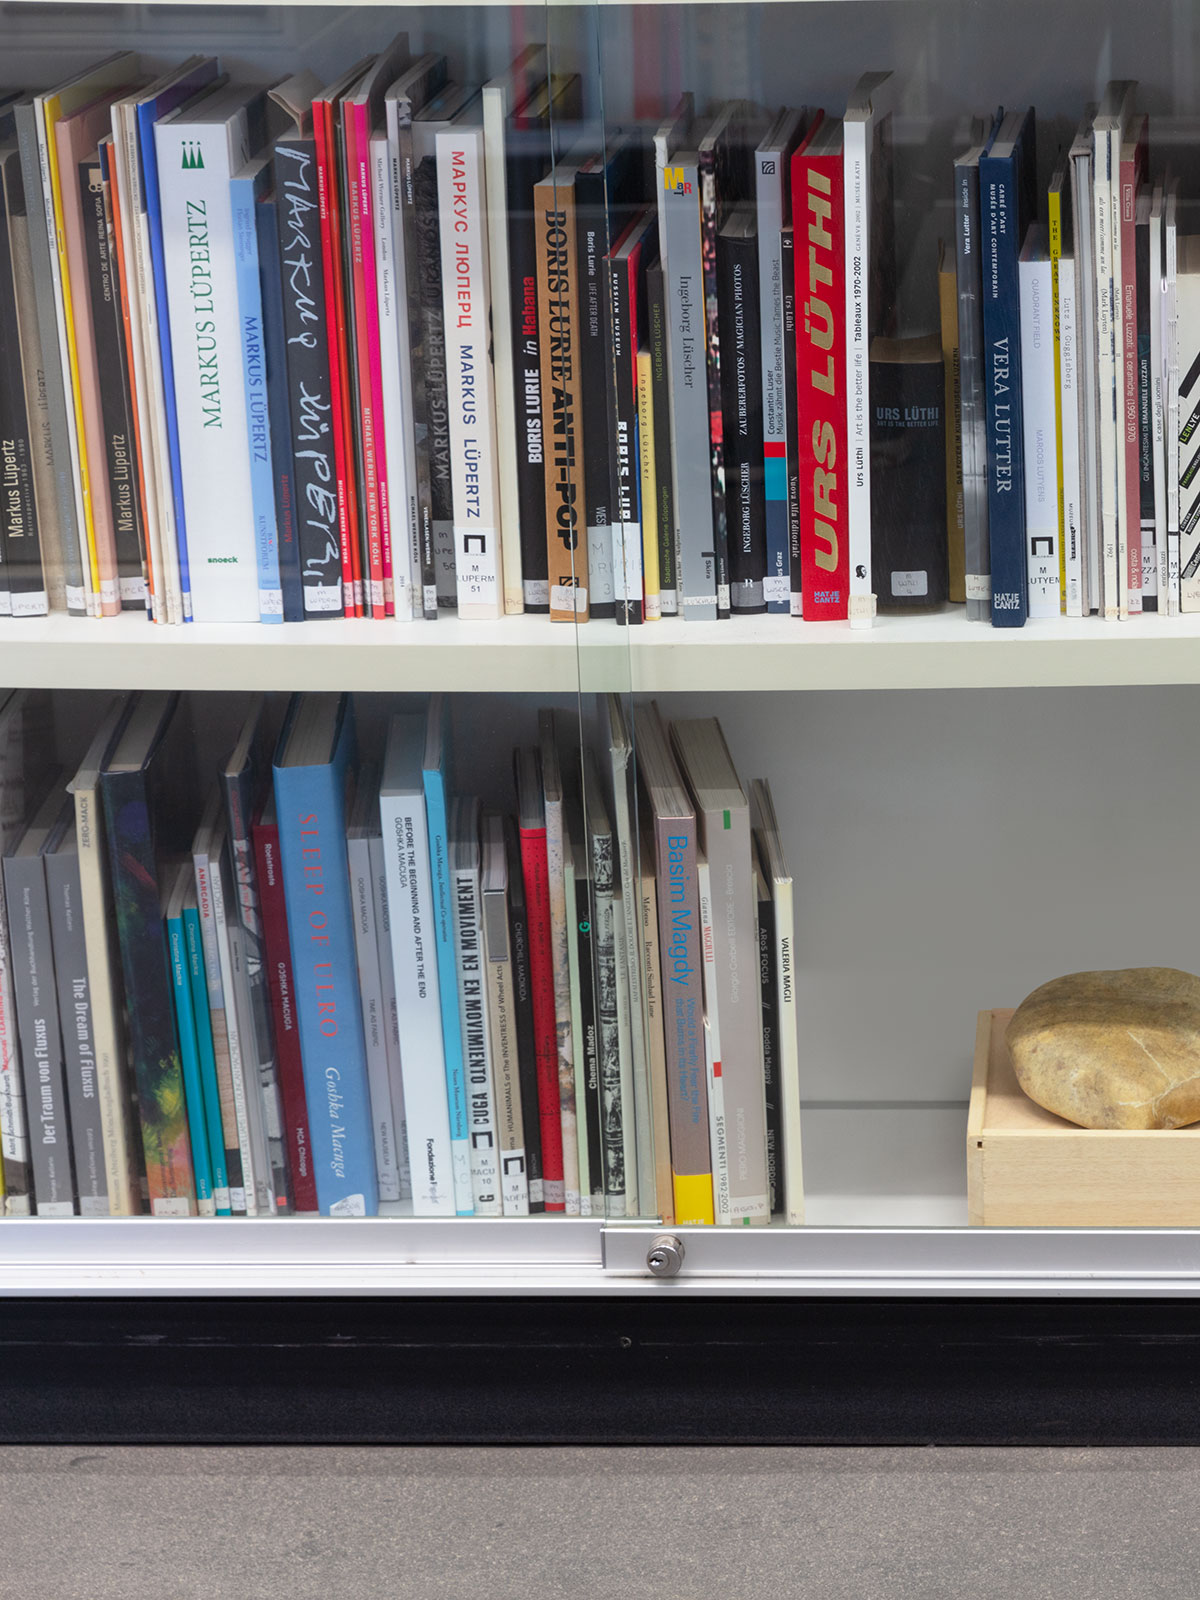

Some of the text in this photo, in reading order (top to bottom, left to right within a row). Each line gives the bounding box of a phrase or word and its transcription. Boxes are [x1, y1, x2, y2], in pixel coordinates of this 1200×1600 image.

[452, 151, 472, 328] МАРКУС ЛЮПЕРЦ
[186, 200, 222, 428] MARKUS LÜPERTZ
[679, 276, 696, 388] Ingeborg Lüscher
[1063, 298, 1072, 319] Lutz
[1063, 335, 1073, 389] Guggisberg
[245, 317, 267, 462] MARKUS LÜPERTZ
[522, 277, 542, 463] BORIS LURIE in Habana
[545, 210, 578, 550] BORIS LURIE ANTI-POP
[733, 263, 752, 553] INGEBORG LÜSCHER ZAUBERERFOTOS MAGICIAN PHOTOS
[805, 168, 838, 572] URS LÜTHI
[877, 406, 939, 420] URS LÜTHI
[994, 338, 1012, 493] VERA LUTTER
[112, 434, 134, 531] Markus Lüpertz
[461, 345, 481, 518] MARKUS LÜPERTZ
[640, 374, 651, 480] Ingeborg Lüscher
[2, 440, 24, 537] Markus Lüpertz
[208, 556, 238, 564] snoeck
[705, 560, 713, 579] Skira
[995, 601, 1019, 609] CANTZ
[299, 814, 338, 1038] SLEEP OF ULRO
[405, 817, 427, 998] BEFORE THE BEGINNING AND AFTER THE END
[457, 878, 479, 971] EN MOVIMENT
[668, 836, 694, 986] Basim Magdy
[781, 937, 792, 1002] VALERIA MAGLI
[34, 1019, 56, 1144] Der Traum von Fluxus
[73, 977, 94, 1098] The Dream of Fluxus
[464, 980, 486, 1084] EN MOVIMIENTO
[586, 1025, 597, 1089] Chema Madoz
[325, 1067, 347, 1179] Goshka Macuga
